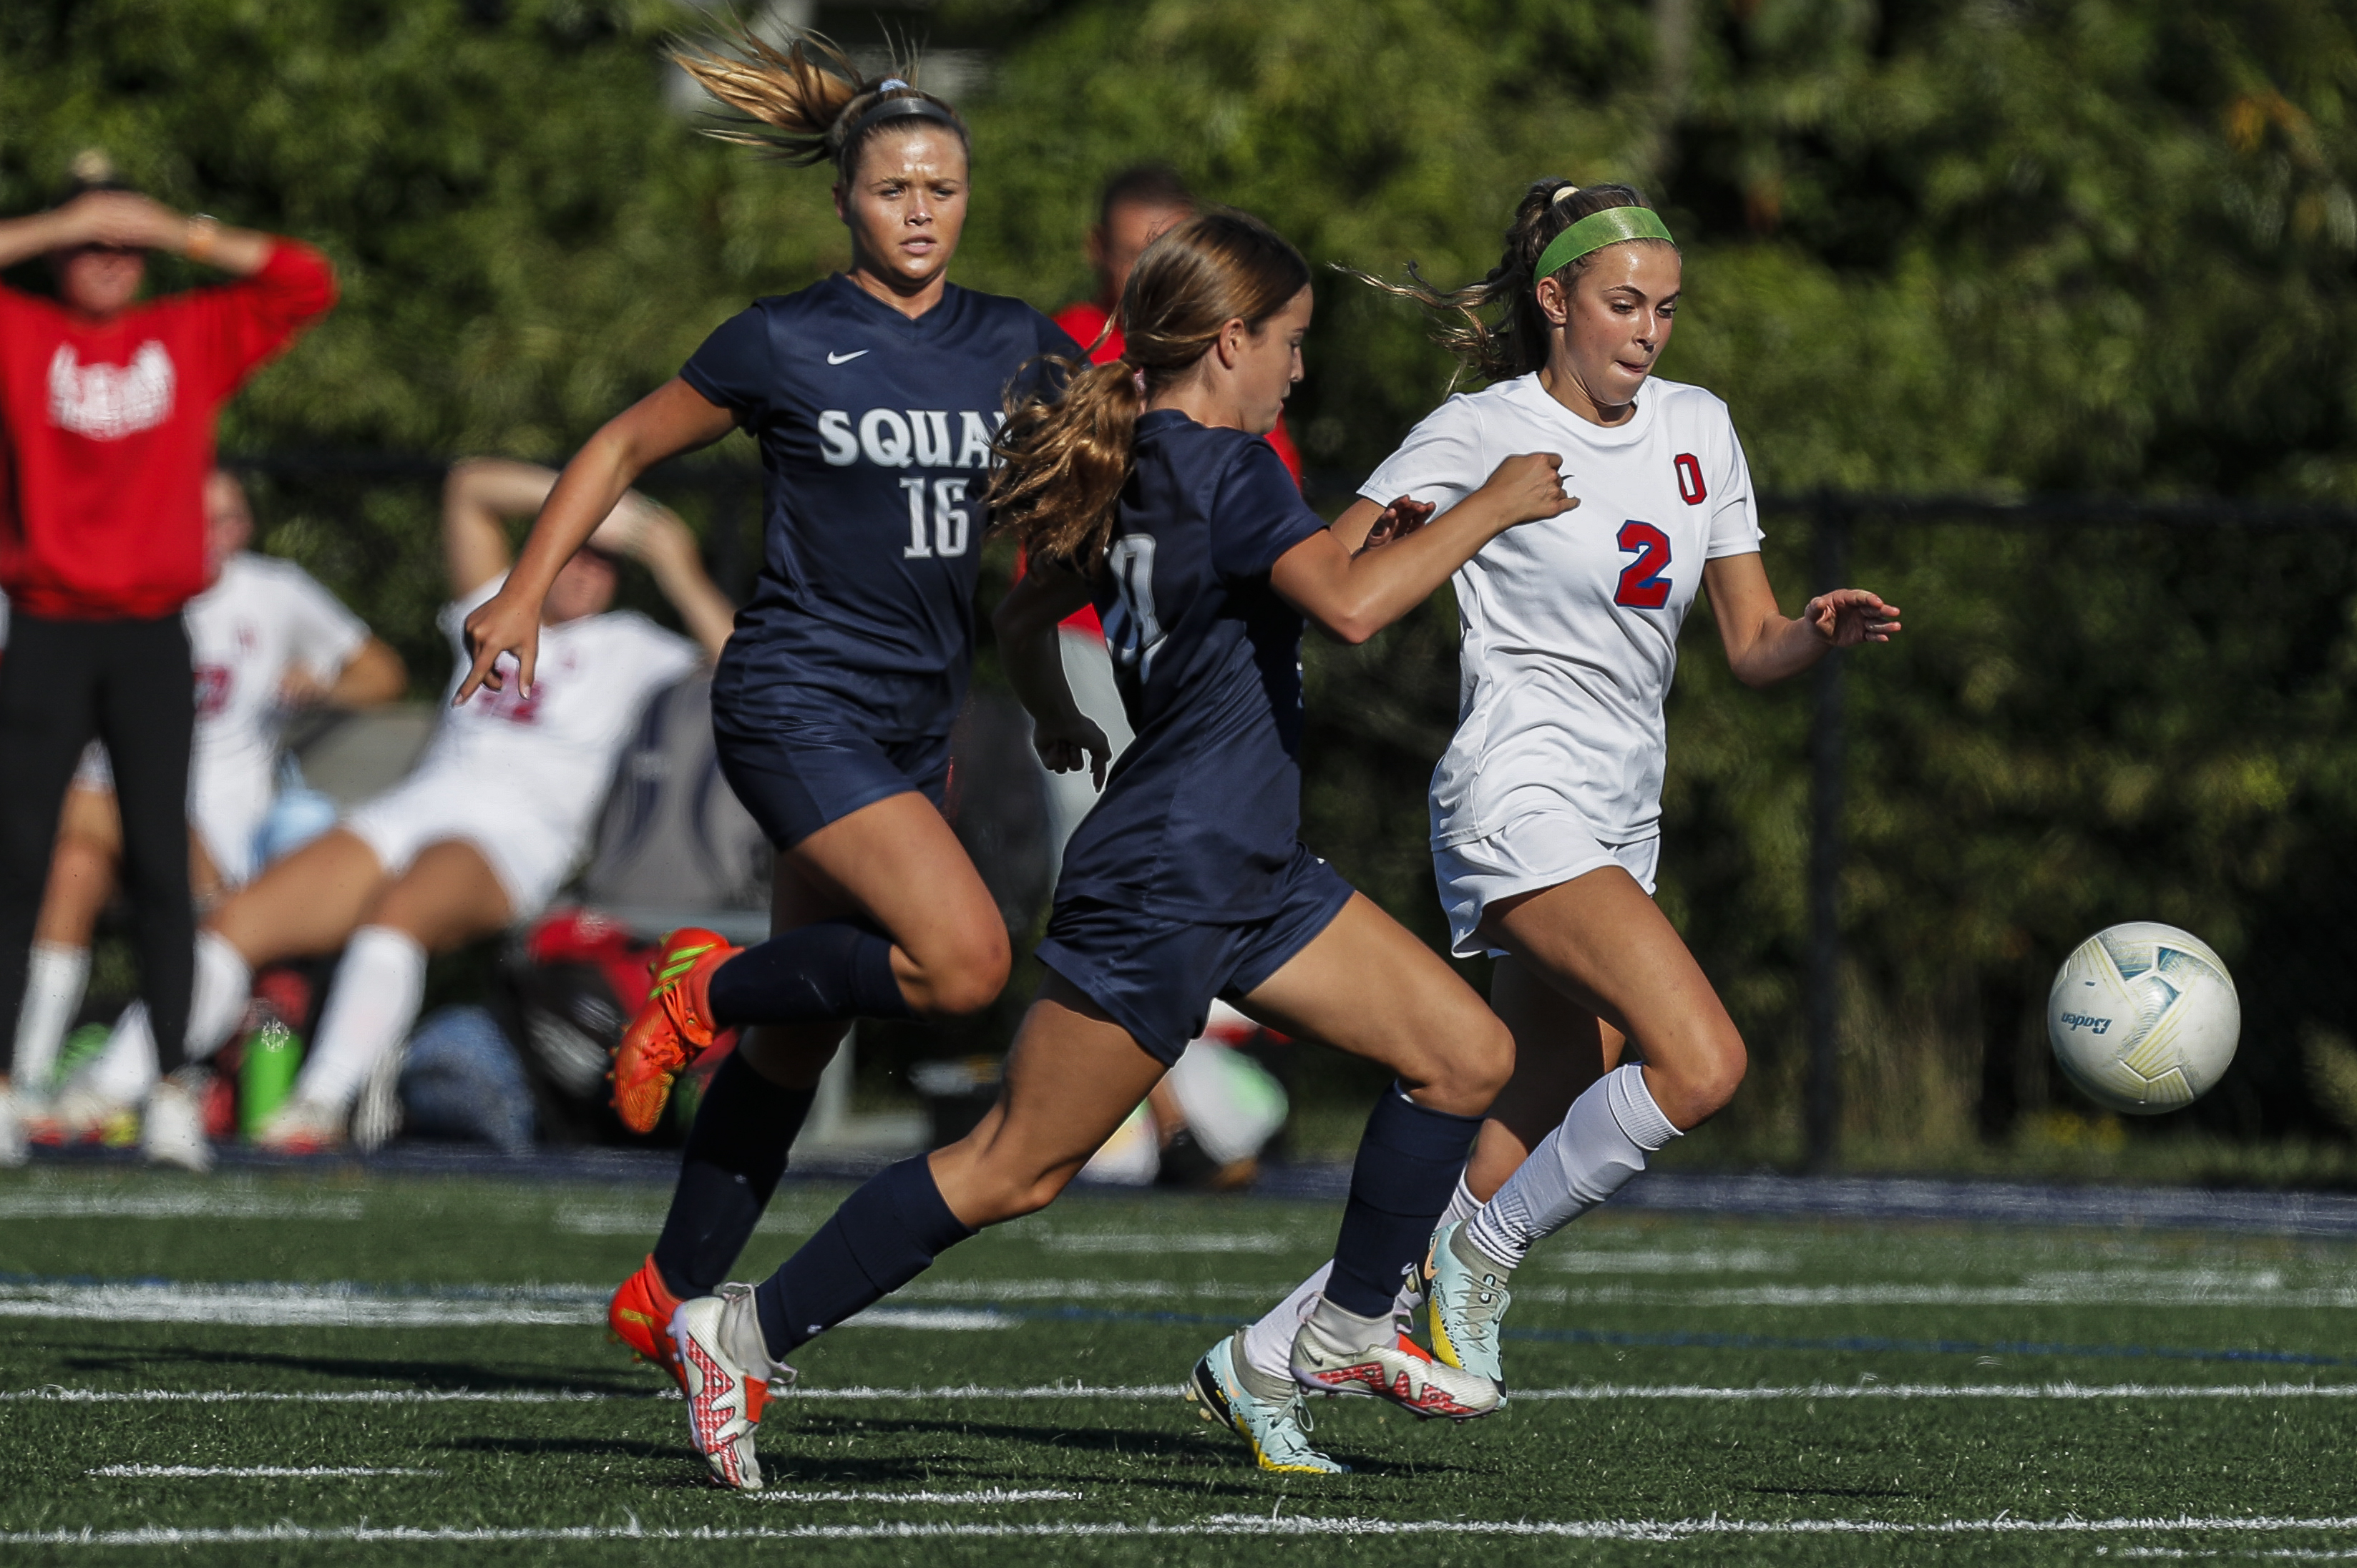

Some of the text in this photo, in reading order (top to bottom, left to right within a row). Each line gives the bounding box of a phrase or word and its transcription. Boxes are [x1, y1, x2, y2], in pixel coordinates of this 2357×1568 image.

[817, 407, 1007, 469] SQUA
[899, 476, 970, 559] 16
[1614, 519, 1673, 609] 2
[2061, 1011, 2113, 1035] Baden
